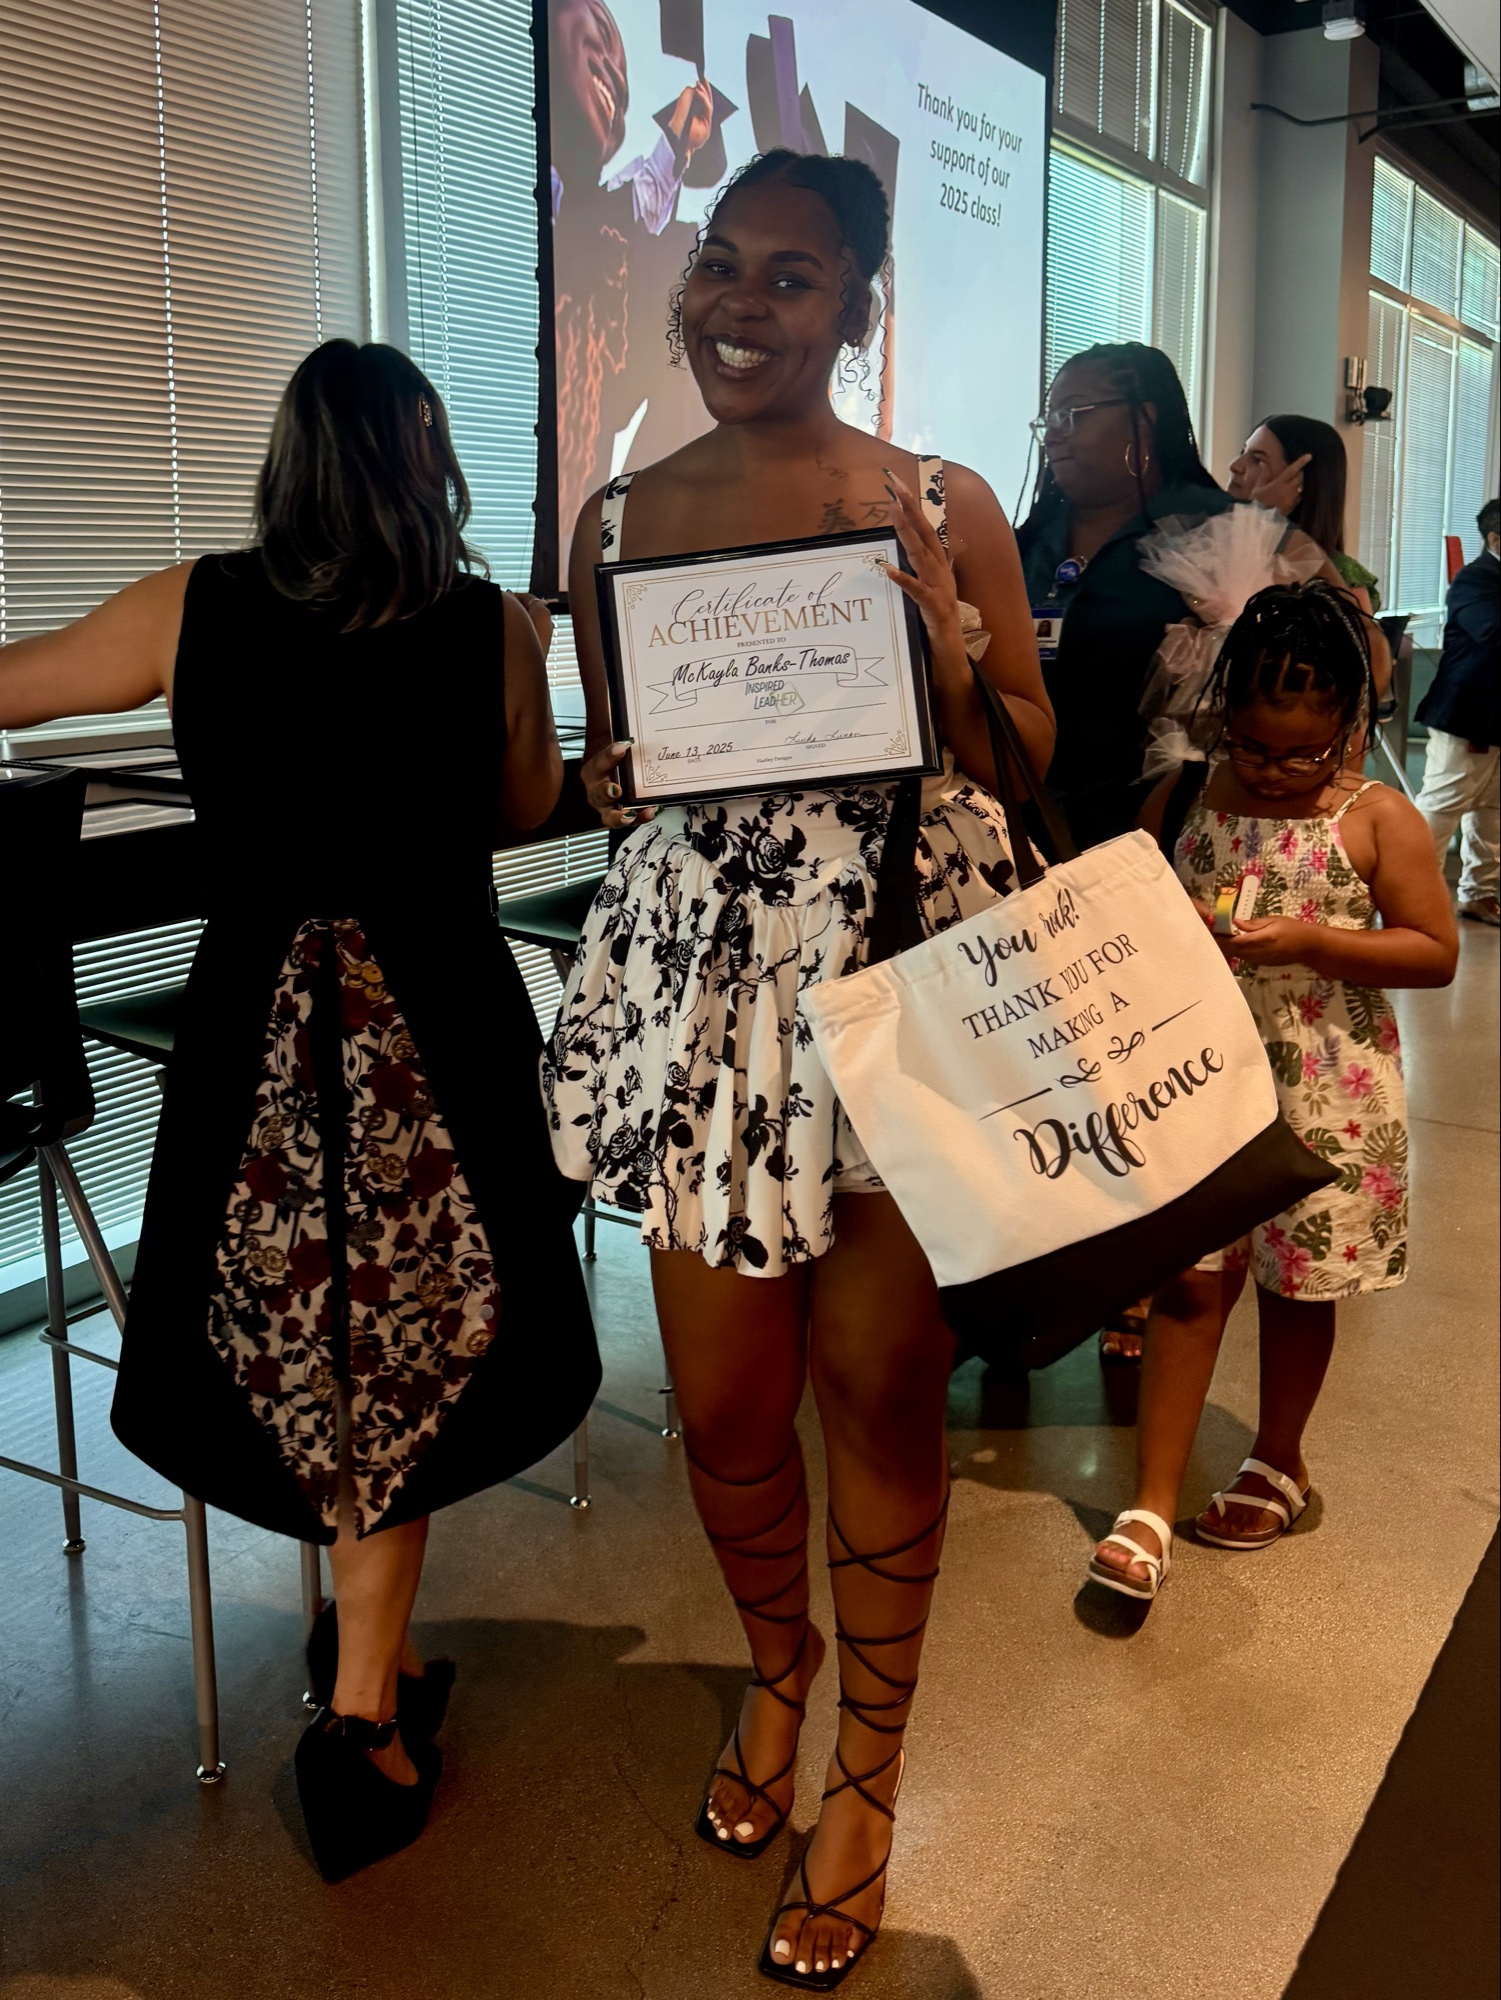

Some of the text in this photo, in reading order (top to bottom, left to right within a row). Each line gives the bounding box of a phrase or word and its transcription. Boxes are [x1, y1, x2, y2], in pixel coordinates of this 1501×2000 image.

[917, 82, 1023, 154] Thank you for your
[930, 140, 1011, 189] support of our
[940, 182, 1002, 228] 2025 class!
[648, 597, 873, 648] ACHIEVEMENT
[671, 571, 843, 624] Certificate of
[672, 648, 851, 688] McKayla Banks-Thomas
[736, 638, 776, 648] PRESENTED
[744, 679, 785, 696] INSPIRED
[658, 746, 682, 761] June
[706, 741, 734, 755] 2025
[957, 887, 1081, 988] You rock!
[962, 933, 1140, 1040] THANK YOU FOR
[1026, 990, 1131, 1059] MAKING A
[1012, 1047, 1224, 1180] Difference
